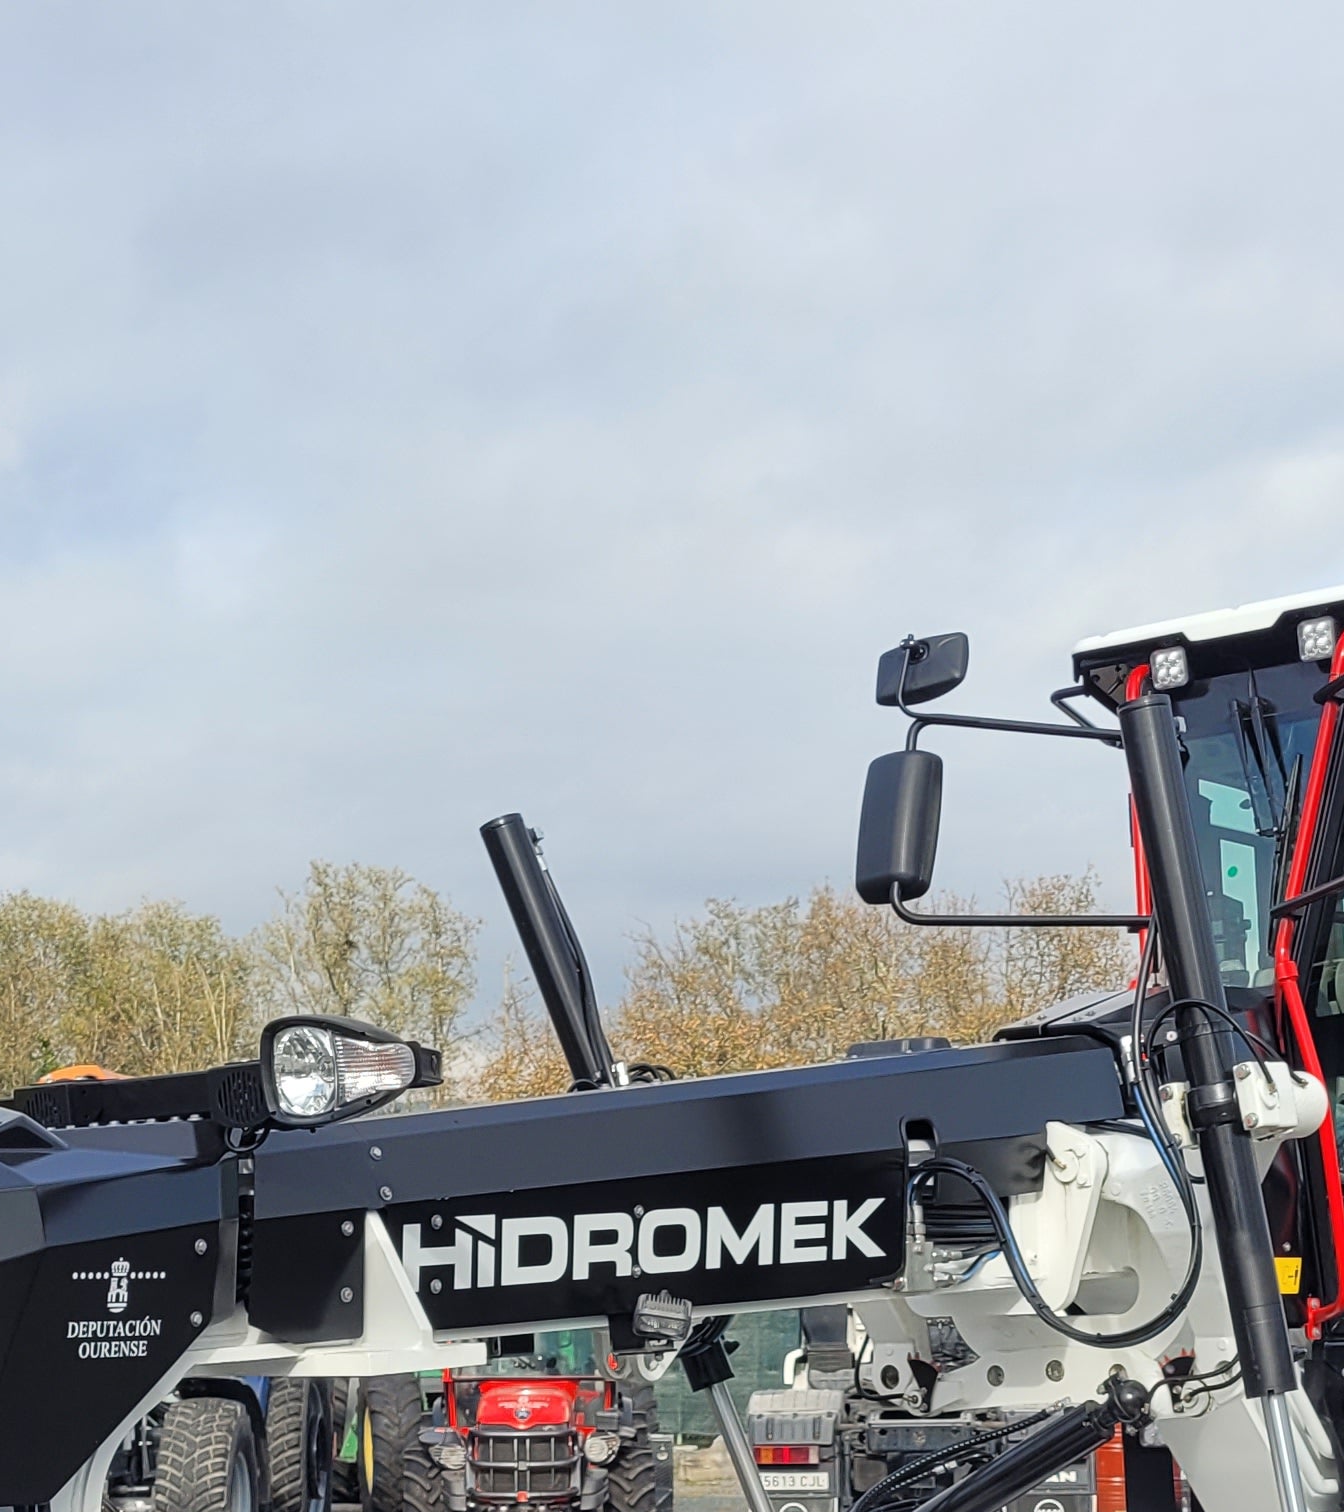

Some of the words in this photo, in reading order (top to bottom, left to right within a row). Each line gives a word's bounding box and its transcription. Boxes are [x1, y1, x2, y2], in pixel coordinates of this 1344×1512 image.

[66, 1315, 163, 1339] DEPUTACIÓN
[77, 1340, 149, 1359] OURENSE
[763, 1475, 796, 1488] 5613
